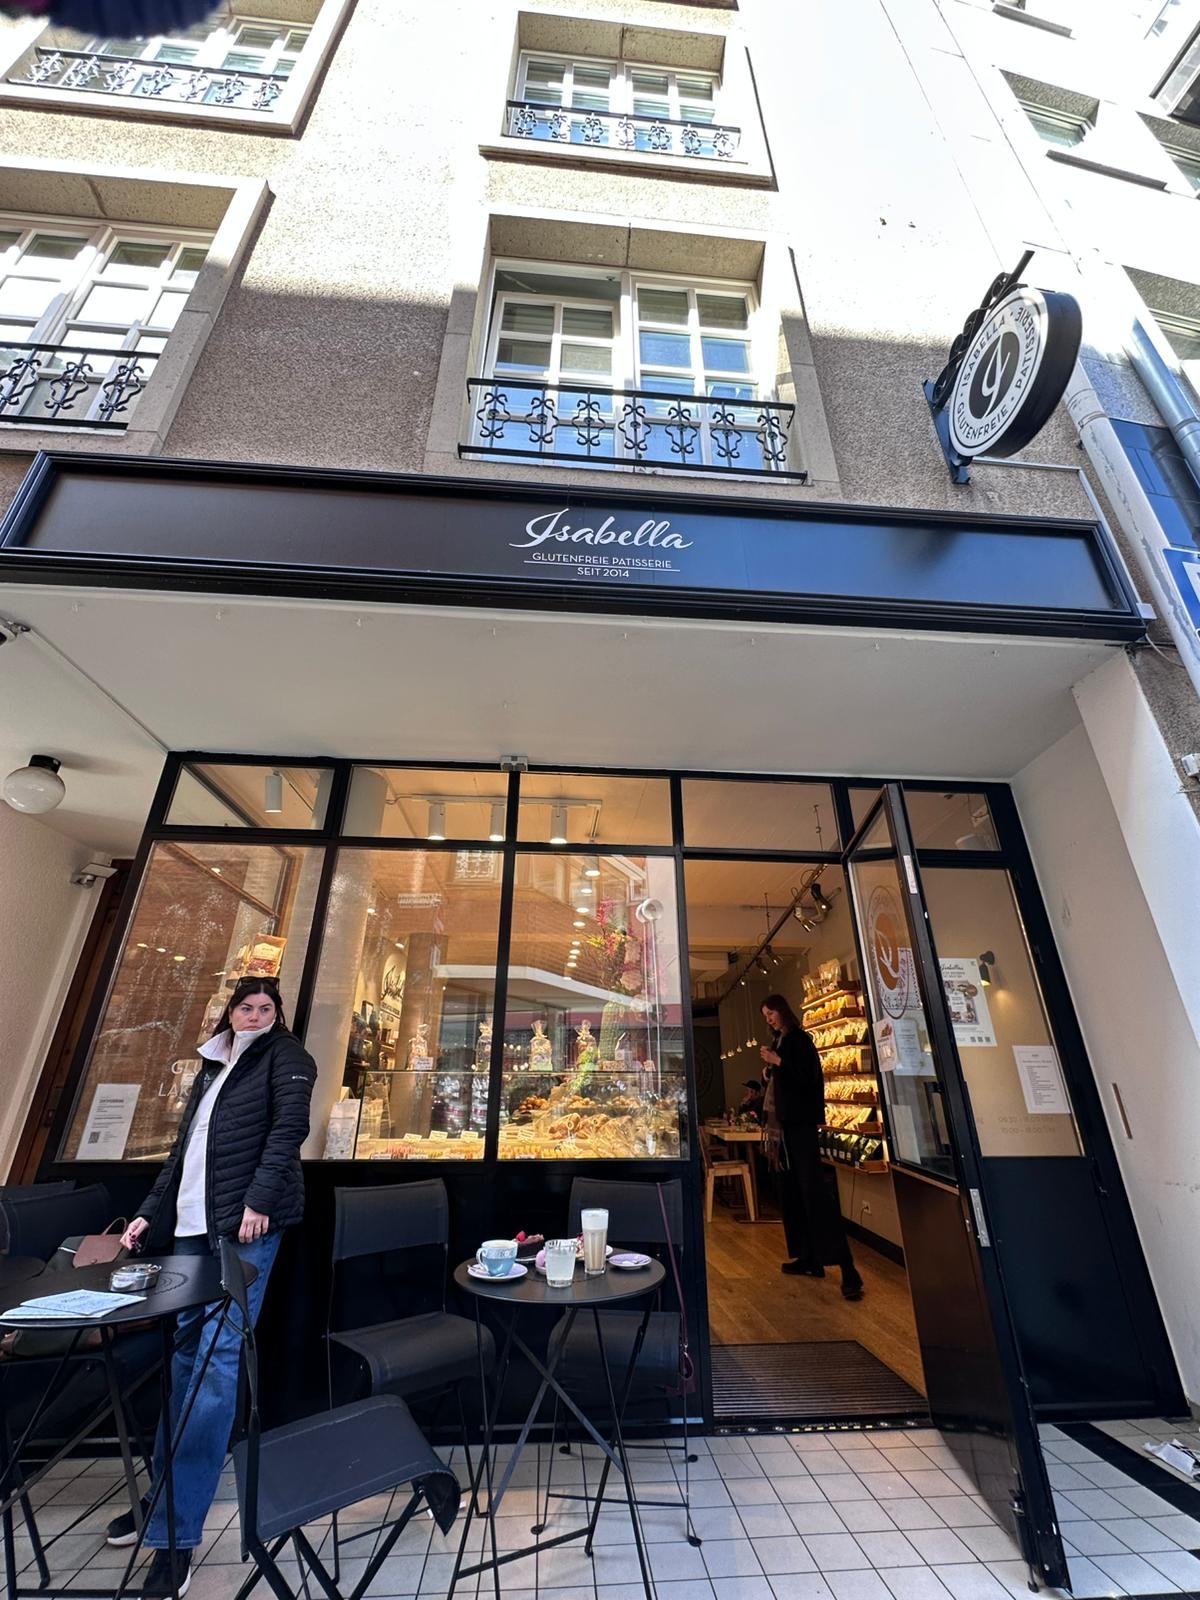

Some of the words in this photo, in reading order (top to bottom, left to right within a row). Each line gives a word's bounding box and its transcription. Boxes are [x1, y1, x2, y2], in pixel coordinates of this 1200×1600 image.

[962, 314, 1006, 387] ISABELLA
[1014, 307, 1037, 389] PATISSERIE
[956, 402, 1008, 440] GLUTENFREIE
[509, 508, 693, 549] Isabella
[532, 552, 609, 565] GLUTENFREIE
[612, 559, 672, 569] PATISSERIE
[577, 567, 600, 577] SEIT
[603, 569, 630, 578] 2014
[158, 1082, 189, 1097] LAK
